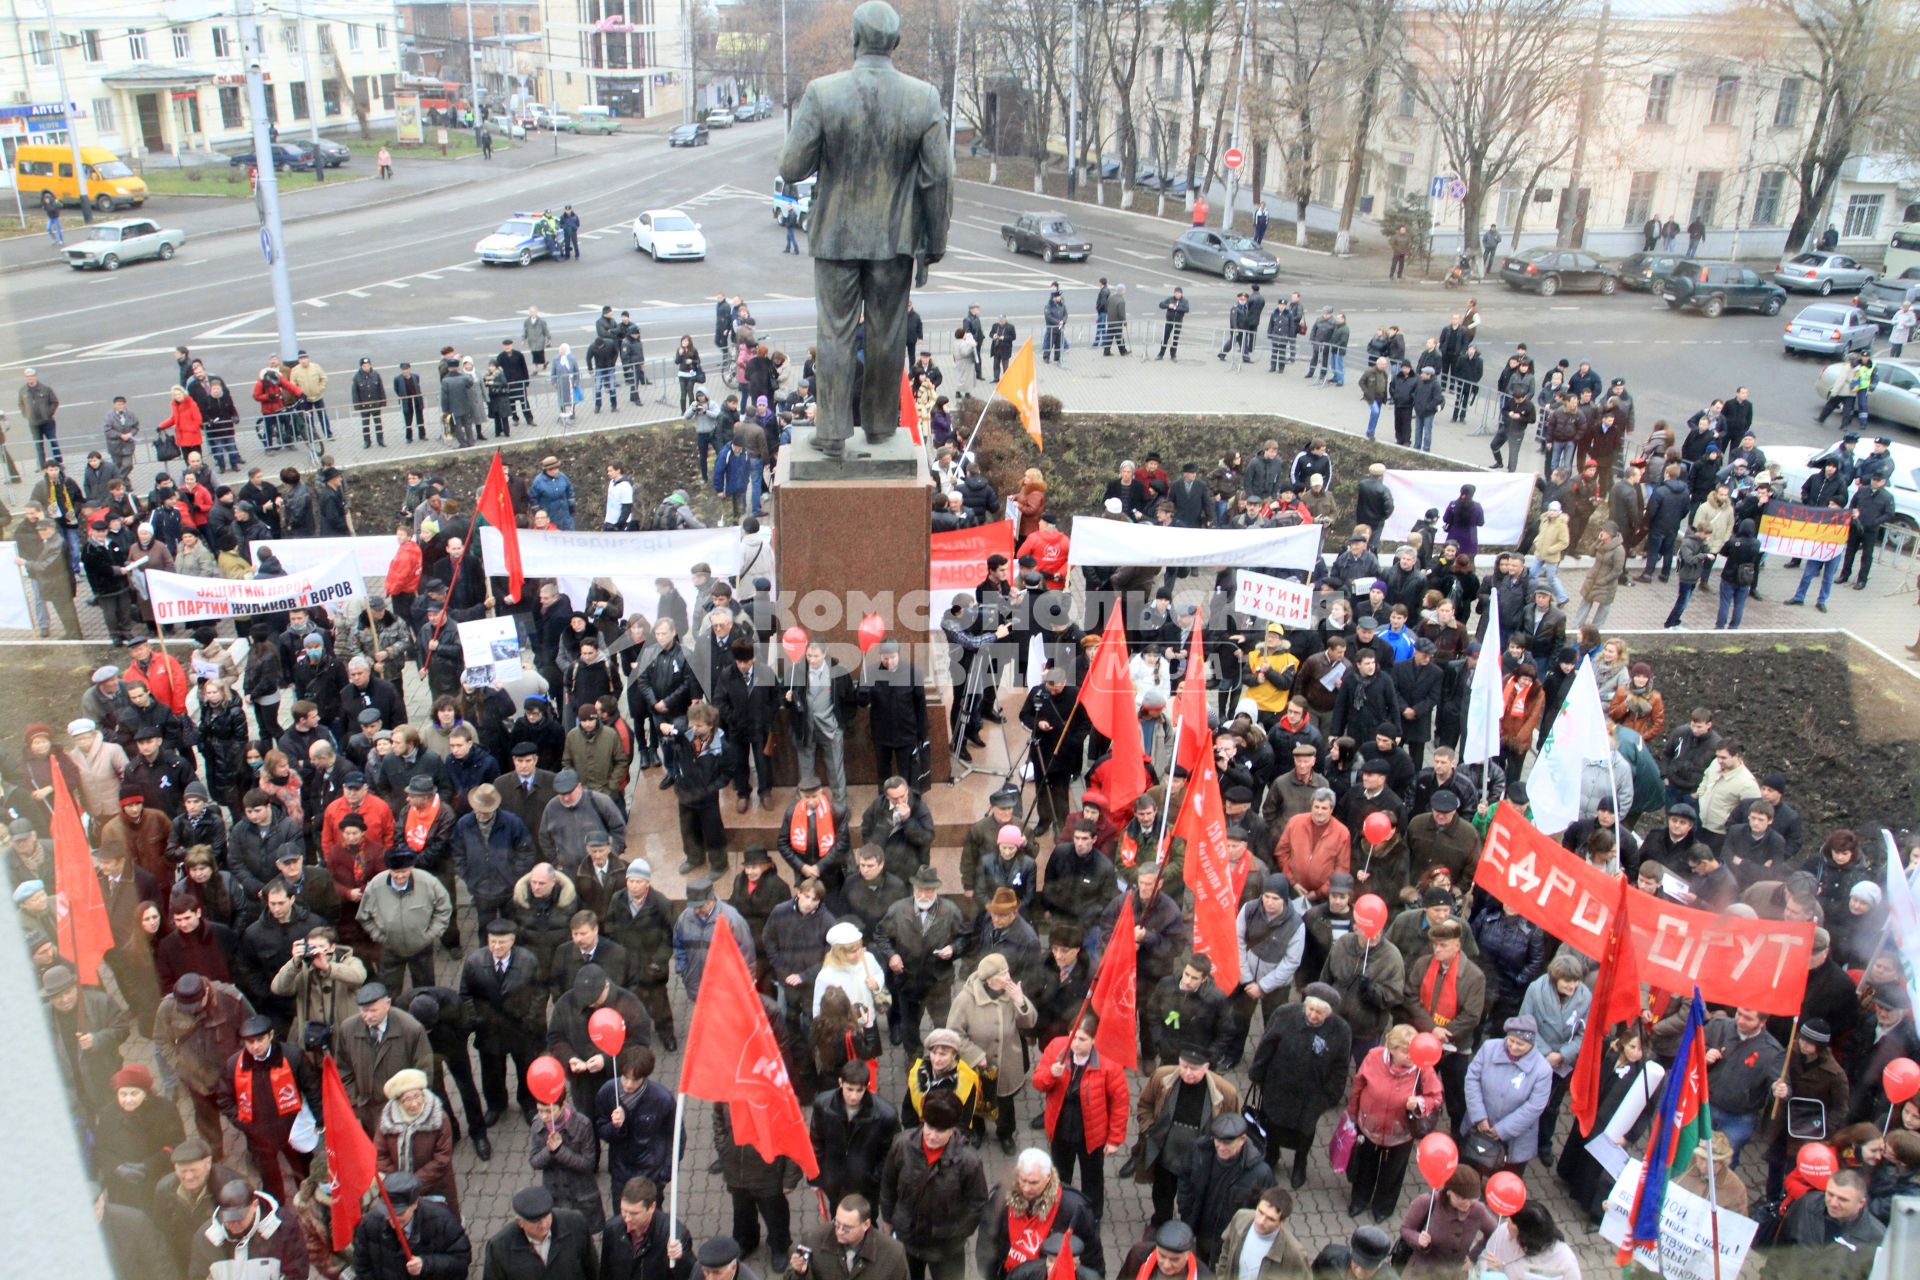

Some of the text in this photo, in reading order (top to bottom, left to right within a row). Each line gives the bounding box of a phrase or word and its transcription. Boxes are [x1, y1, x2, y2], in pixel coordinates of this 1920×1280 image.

[1764, 527, 1840, 560] РОССИЯ
[158, 601, 174, 619] ОТ
[178, 599, 229, 617] ПАРТИИ
[299, 594, 309, 607] И
[310, 580, 353, 605] ВОРОВ
[197, 583, 265, 602] ЗАЩИТИМ
[1243, 579, 1301, 605] ПУТИН
[1483, 822, 1609, 936] ЕДРО
[1008, 1247, 1027, 1263] КПР
